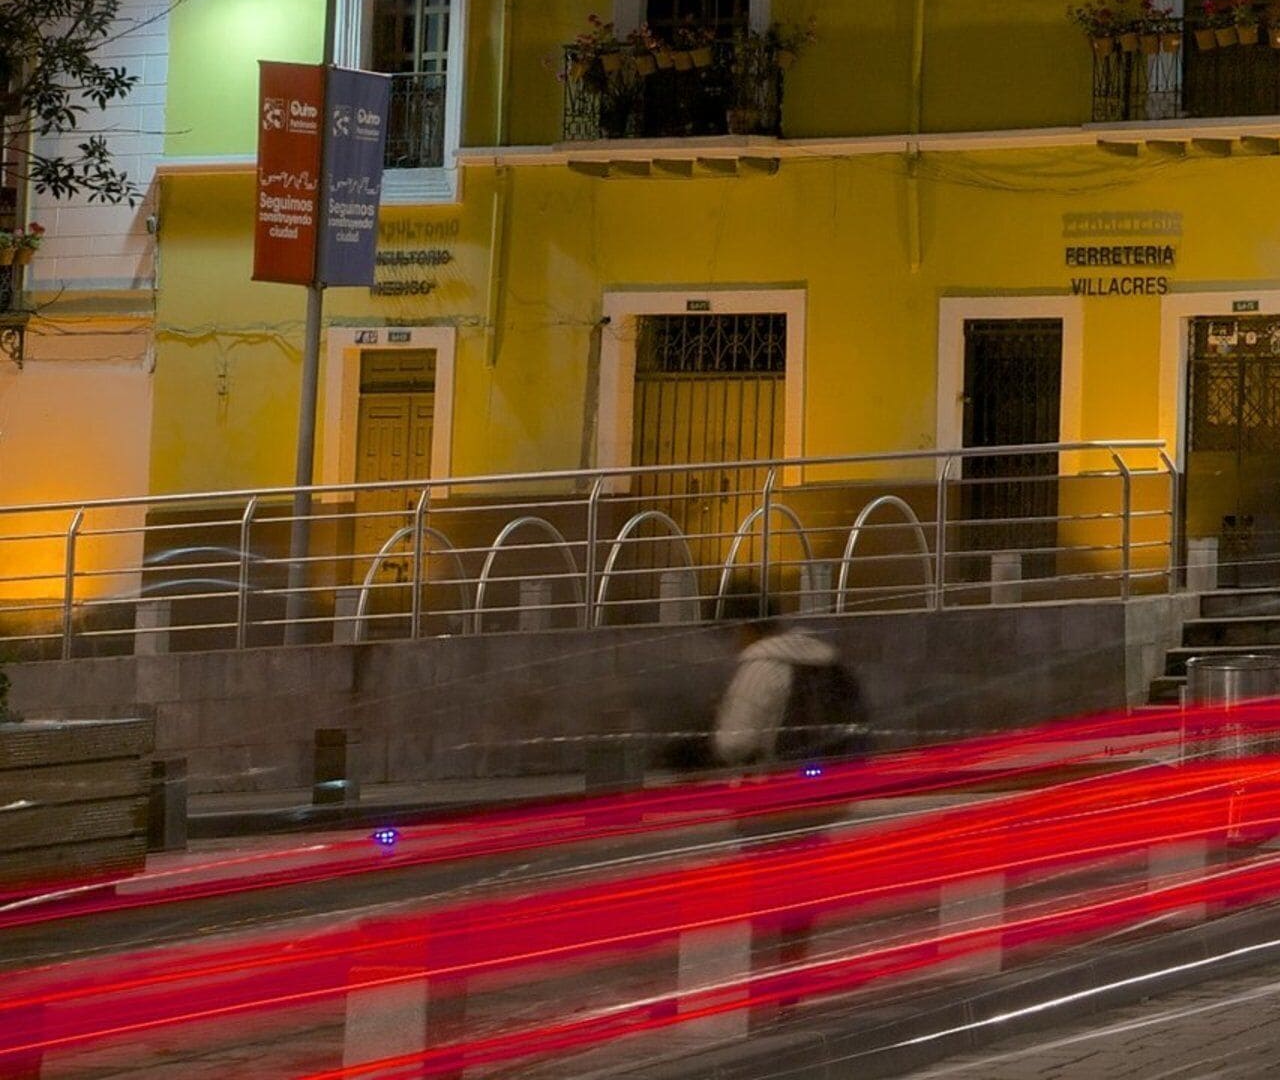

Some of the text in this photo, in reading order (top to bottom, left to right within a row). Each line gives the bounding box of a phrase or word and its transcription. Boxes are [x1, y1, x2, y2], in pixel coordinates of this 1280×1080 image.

[259, 192, 313, 212] Seguimos
[328, 198, 375, 217] Seguimos
[269, 225, 298, 239] ciudad
[1065, 245, 1175, 265] FERRETERIA
[1071, 277, 1168, 296] VILLACRES
